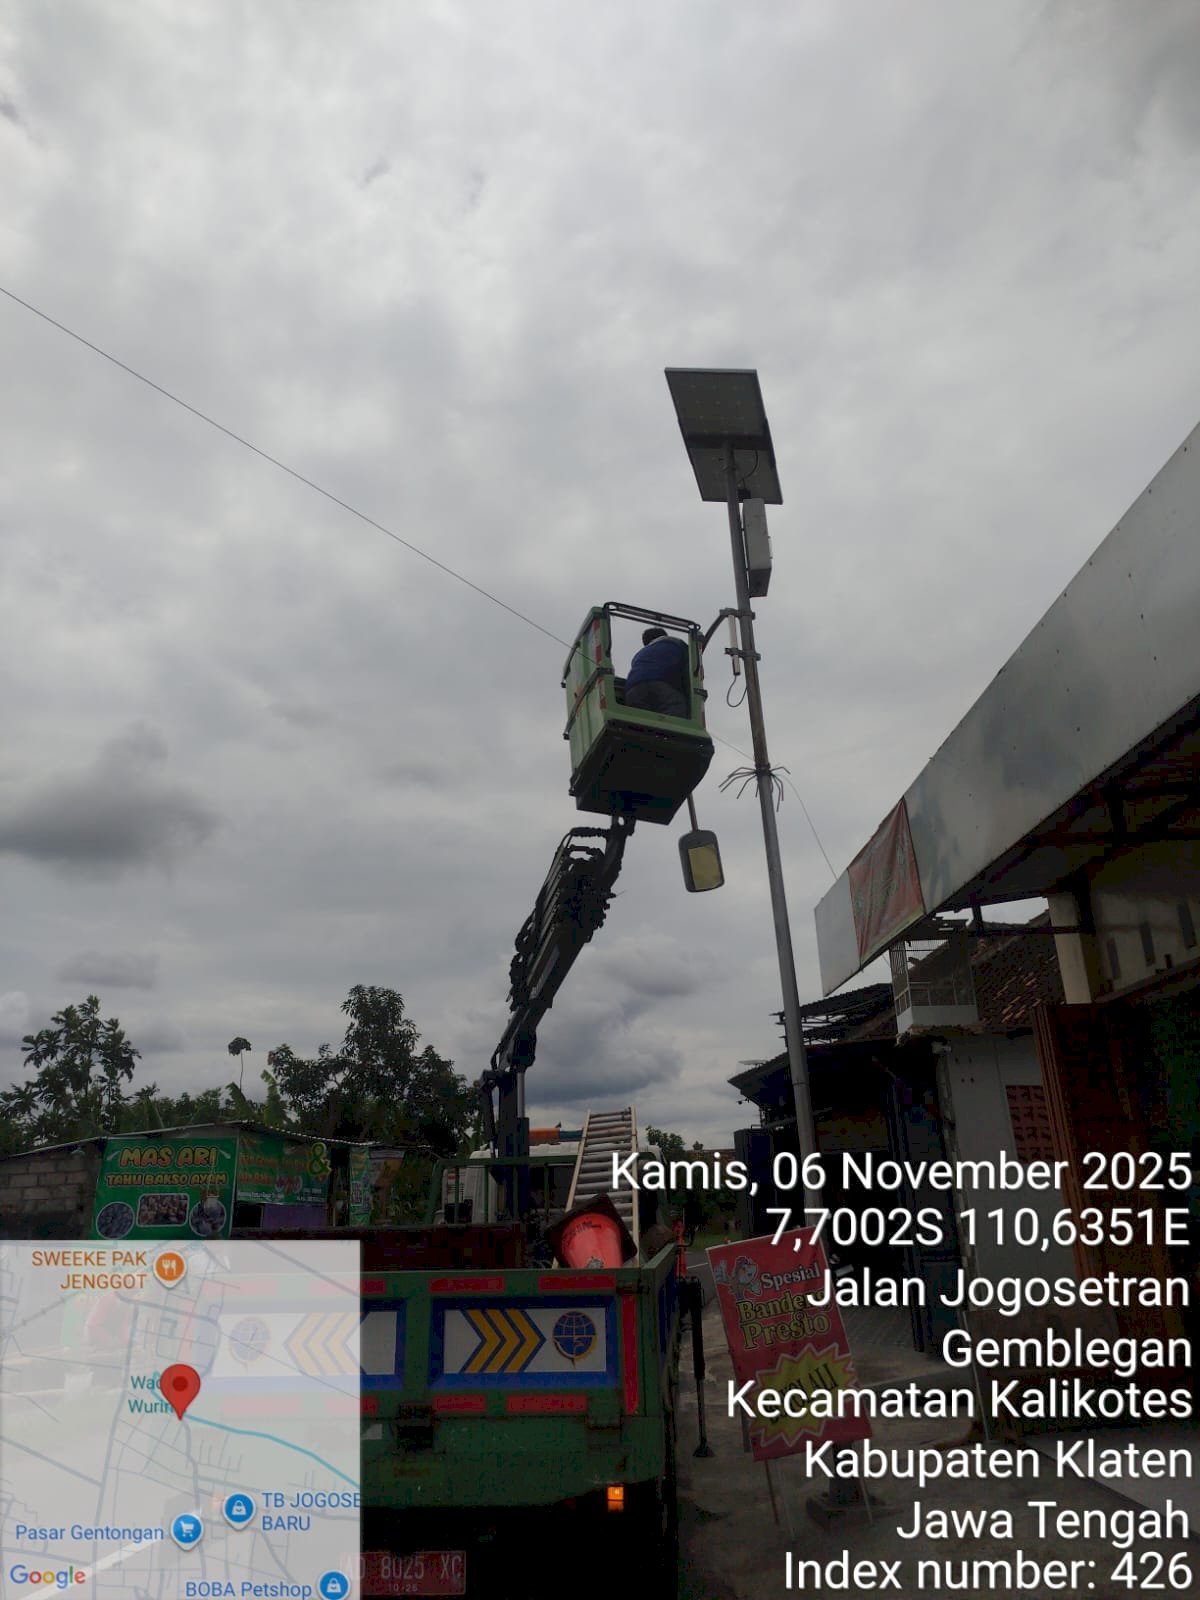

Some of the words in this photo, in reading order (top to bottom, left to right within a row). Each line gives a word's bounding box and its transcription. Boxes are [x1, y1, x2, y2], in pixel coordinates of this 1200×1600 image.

[120, 1145, 173, 1168] MAS
[177, 1146, 218, 1168] ARI
[107, 1172, 142, 1187] TAHU
[143, 1172, 188, 1187] BAKSO
[190, 1172, 228, 1187] AYAM
[760, 1262, 820, 1291] Spesial
[741, 1313, 831, 1350] Presto
[380, 1556, 425, 1580] 8025
[440, 1555, 462, 1580] XC
